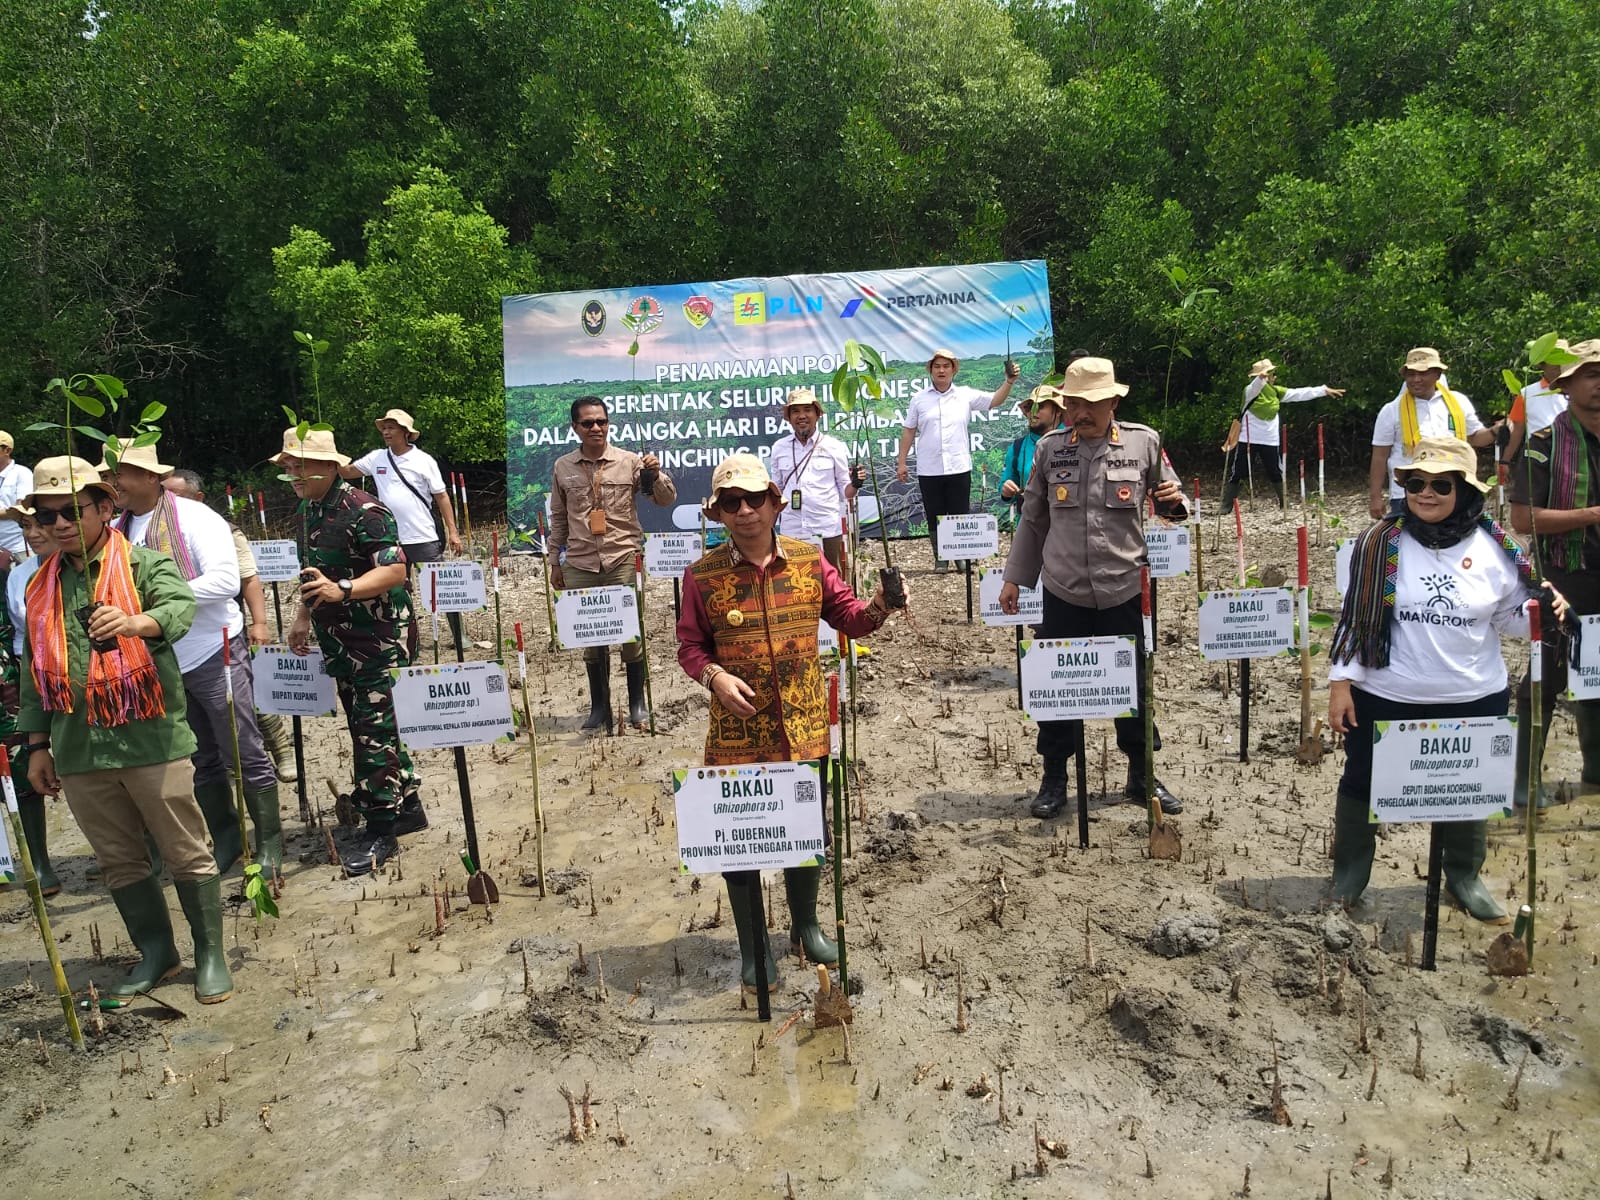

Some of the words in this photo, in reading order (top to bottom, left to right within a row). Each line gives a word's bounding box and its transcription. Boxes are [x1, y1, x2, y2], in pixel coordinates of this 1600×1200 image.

[770, 295, 823, 316] PLN
[887, 291, 977, 309] PERTAMINA
[655, 356, 798, 384] PENANAMAN
[604, 390, 713, 415] SERENTAK
[823, 376, 929, 402] IONESI
[523, 424, 584, 447] DALA
[608, 421, 703, 443] RANGKA
[707, 417, 759, 438] HARI
[765, 413, 829, 435] BAI
[835, 408, 910, 431] RIMBA
[971, 400, 1023, 422] KE-4
[1107, 459, 1139, 468] POLRI
[956, 522, 979, 530] BAKAU
[663, 540, 685, 548] BAKAU
[1145, 534, 1167, 543] AKAU
[438, 570, 463, 578] BAKAU
[581, 594, 611, 607] BAKAU
[1229, 600, 1263, 614] BAKAU
[1399, 610, 1477, 627] MANGROVE
[573, 623, 593, 631] KEPALA
[1216, 630, 1252, 641] SEKRETARIS
[1253, 630, 1277, 639] DAERAH
[1204, 641, 1229, 650] PROVINSI
[1245, 639, 1271, 648] TENGGARA
[277, 659, 308, 671] BAKAU
[1057, 652, 1099, 667] BAKAU
[272, 691, 292, 700] BUPATI
[293, 691, 318, 701] KUPANG
[428, 681, 471, 698] BAKAU
[1029, 689, 1056, 699] KEPALA
[1058, 687, 1100, 698] KEPOLISIAN
[1101, 686, 1130, 696] DAERAH
[1029, 700, 1059, 709] PROVINSI
[1060, 699, 1077, 707] NUSA
[1078, 698, 1110, 706] TENGGARA
[1111, 697, 1131, 705] TIMUR
[1420, 737, 1472, 755] BAKAU
[1410, 759, 1461, 770] (Rhizophora
[1462, 757, 1479, 769] sp.)
[721, 778, 773, 798] BAKAU
[1402, 785, 1423, 795] DEPUTI
[1424, 784, 1446, 795] BIDANG
[1447, 783, 1482, 794] KOORDINASI
[713, 802, 765, 814] (Rhizophora
[766, 800, 784, 812] sp.)
[1377, 797, 1418, 807] PENGELOLAAN
[1420, 796, 1457, 807] LINGKUNGAN
[1459, 795, 1470, 805] DAN
[1472, 794, 1507, 805] KEHUTANAN
[715, 829, 729, 842] Pj.
[732, 826, 786, 841] GUBERNUR
[681, 845, 722, 858] PROVINSI
[724, 844, 747, 856] NUSA
[749, 840, 793, 854] TENGGARA
[794, 839, 823, 850] TIMUR
